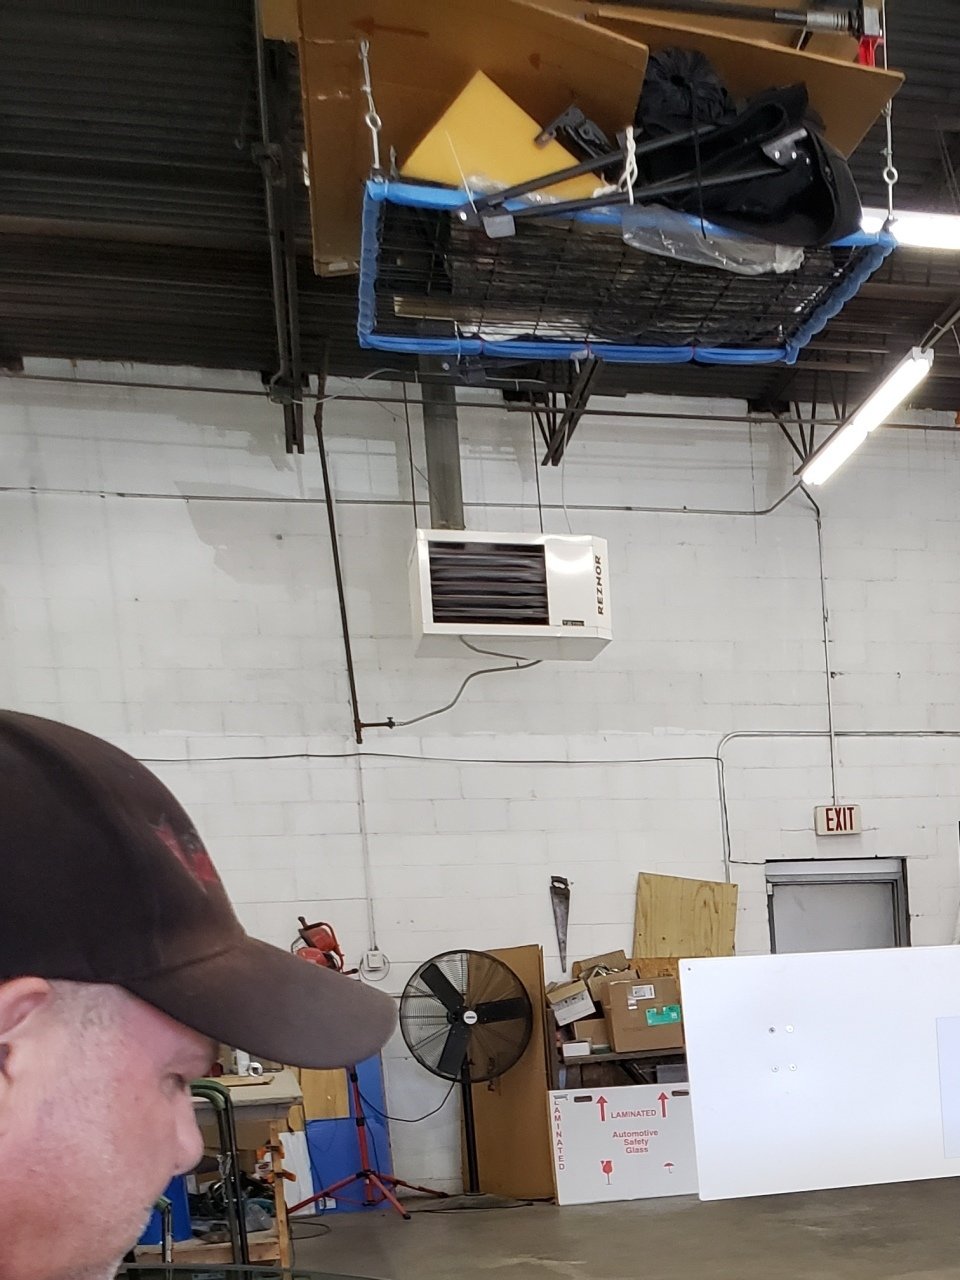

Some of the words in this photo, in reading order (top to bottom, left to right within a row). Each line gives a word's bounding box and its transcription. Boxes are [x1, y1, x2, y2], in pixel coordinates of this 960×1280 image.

[594, 555, 604, 616] REZNOR
[825, 806, 855, 832] EXIT
[610, 1109, 657, 1119] LAMINATED
[612, 1129, 659, 1138] Automotive
[623, 1138, 649, 1147] Safety
[625, 1146, 649, 1154] Glass
